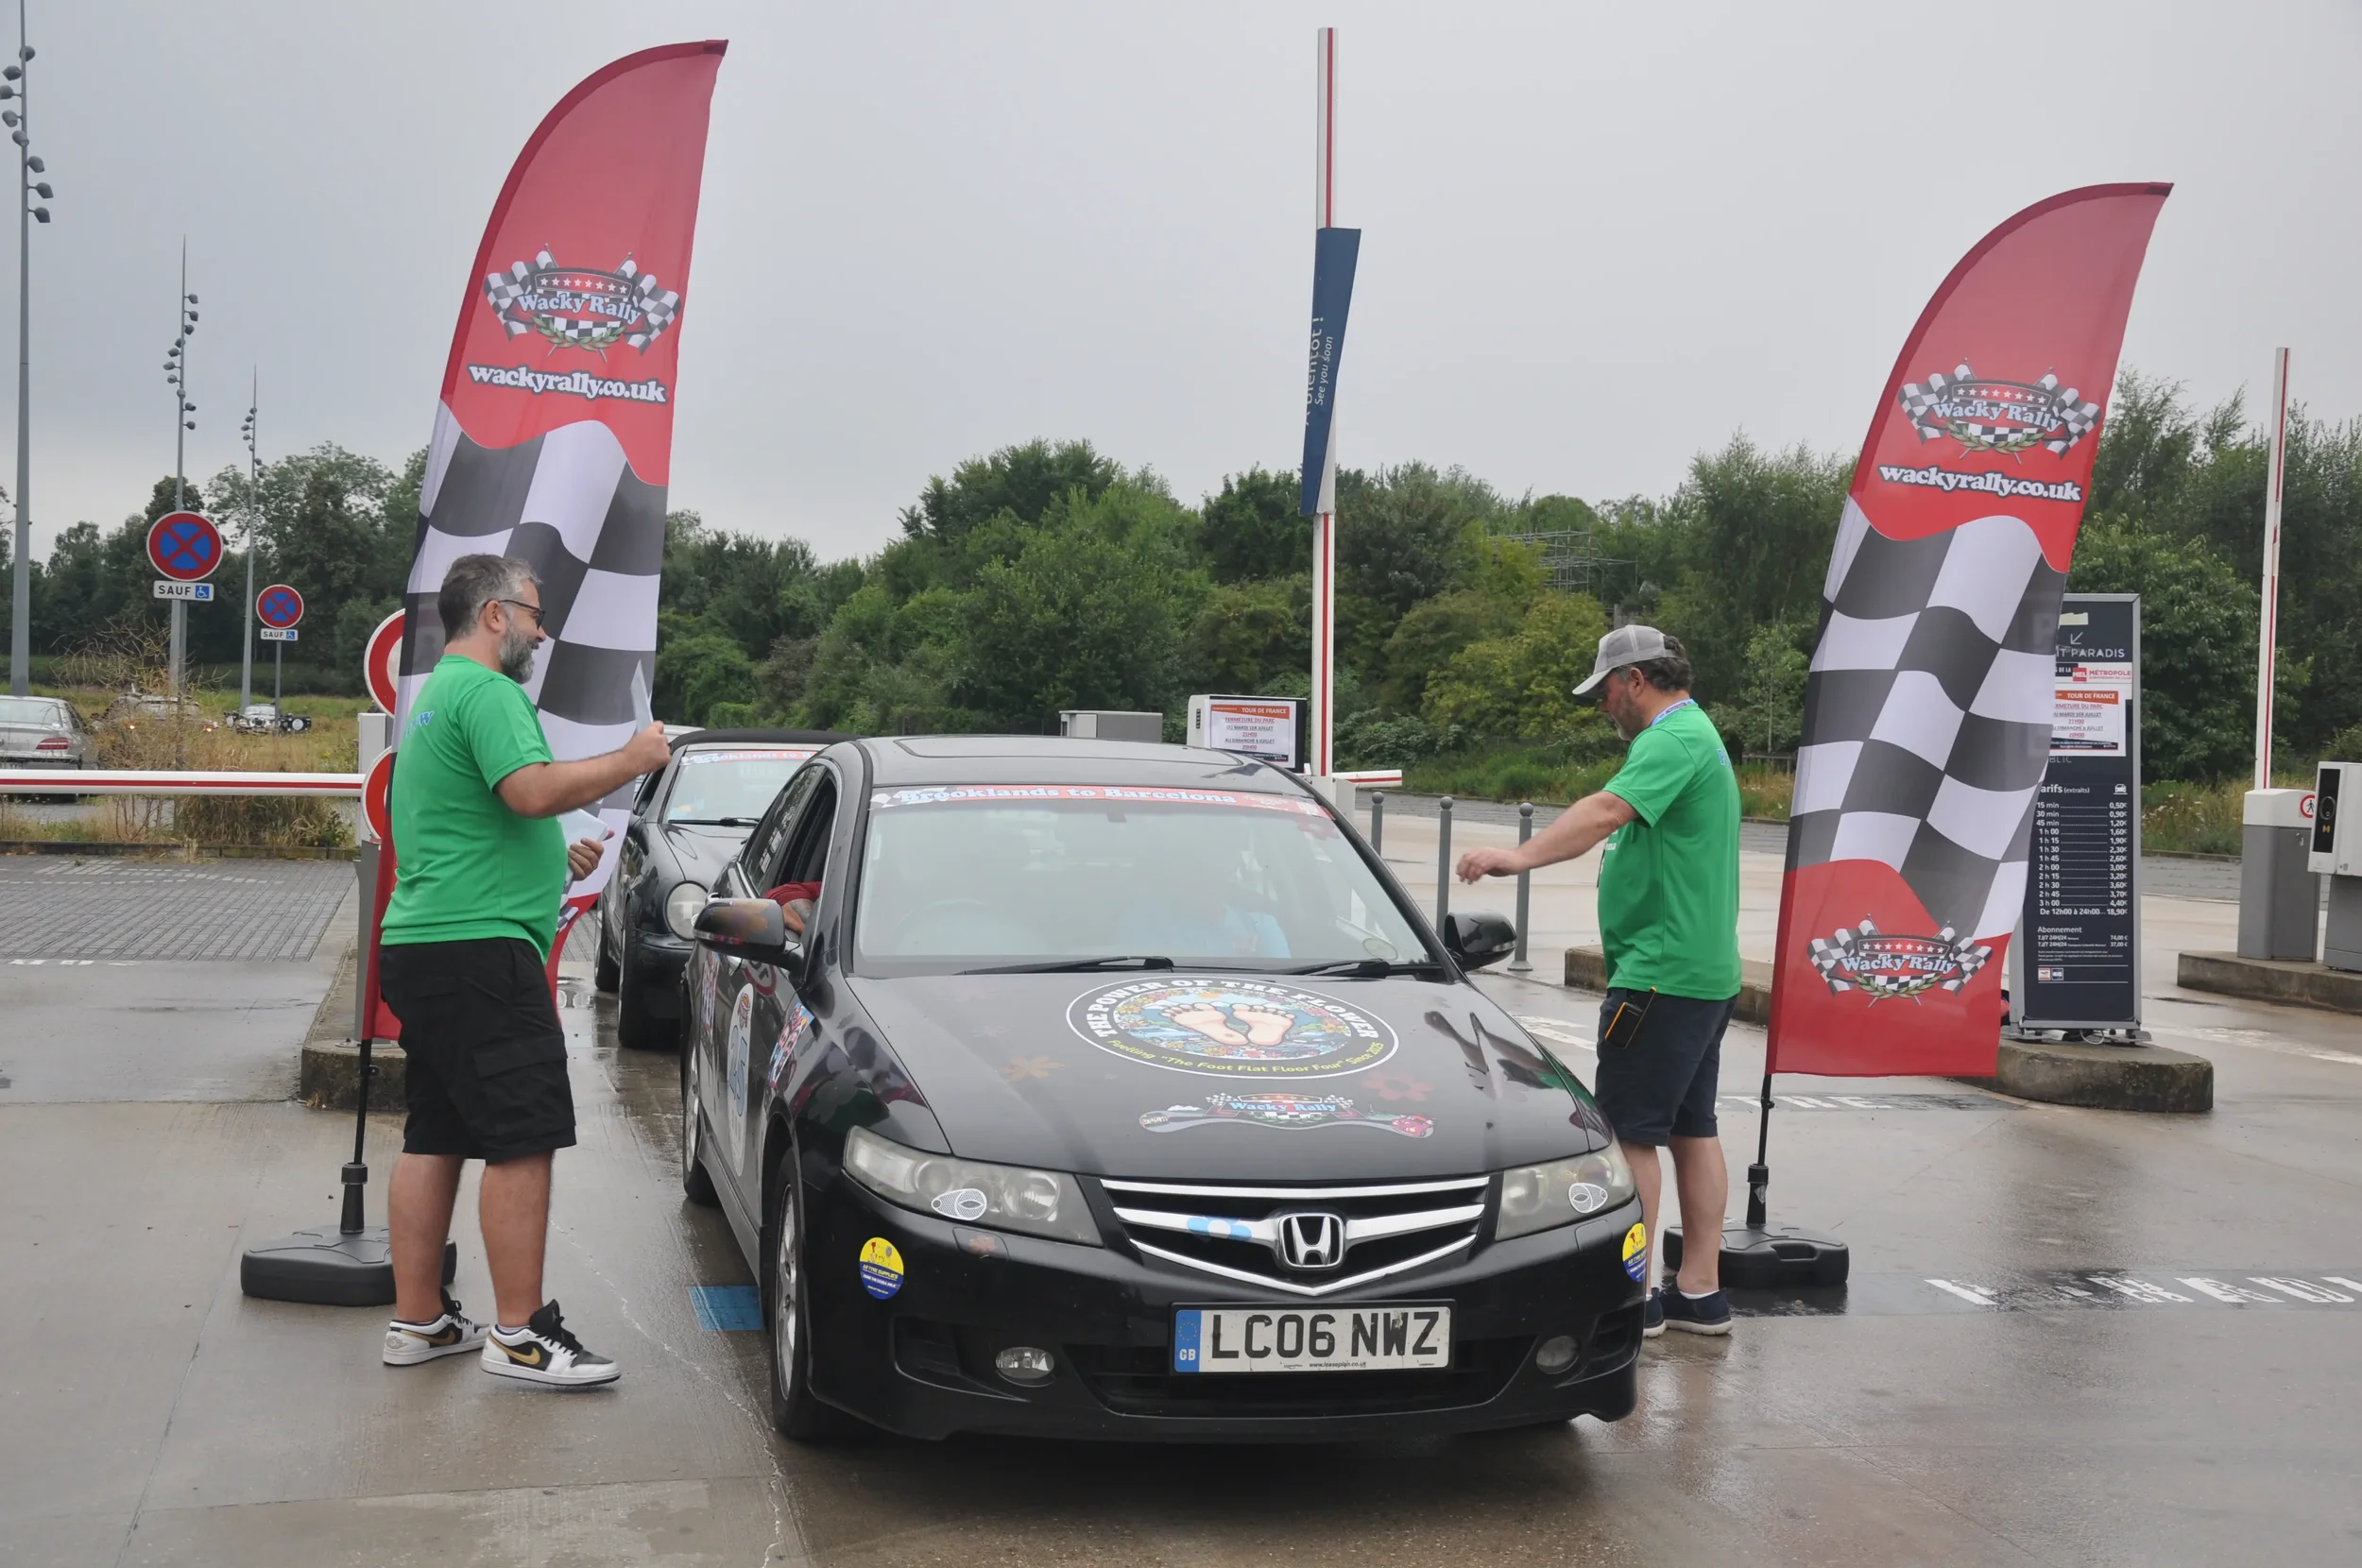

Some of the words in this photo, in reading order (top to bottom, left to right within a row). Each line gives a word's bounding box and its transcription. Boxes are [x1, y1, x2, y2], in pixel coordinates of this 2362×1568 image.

[518, 292, 587, 313] Wacky
[590, 296, 642, 324] Rally
[1324, 336, 1334, 362] soon
[468, 366, 667, 403] wackyrally.co.uk
[1321, 364, 1329, 384] you
[1315, 385, 1326, 405] See
[1932, 401, 2001, 420] Wacky
[2006, 404, 2062, 432] Rally
[1877, 466, 2082, 502] wackyrally.co.uk
[158, 585, 192, 596] SAUF
[2071, 648, 2125, 658] PARADIS
[899, 787, 1060, 802] Brooklands
[1067, 789, 1096, 797] to
[1103, 788, 1237, 803] Barcelona
[2041, 784, 2062, 793] arifs
[1841, 955, 1905, 972] Wacky
[1908, 955, 1958, 974] Rally
[1087, 981, 1169, 1012] POWER
[1221, 980, 1289, 996] THE
[1087, 1014, 1119, 1038] THE
[1291, 993, 1379, 1039] FLOWER
[1107, 1039, 1157, 1060] Fuelling
[1197, 1062, 1233, 1071] Foot
[1238, 1063, 1269, 1072] Flat
[1272, 1062, 1309, 1072] Floor
[1345, 1053, 1373, 1065] Since
[1366, 1041, 1384, 1056] 2025
[1228, 1100, 1287, 1113] Wacky
[1292, 1101, 1337, 1113] Rally
[1179, 1348, 1196, 1361] GB
[1211, 1314, 1337, 1359] LC06
[1351, 1311, 1440, 1357] NWZ
